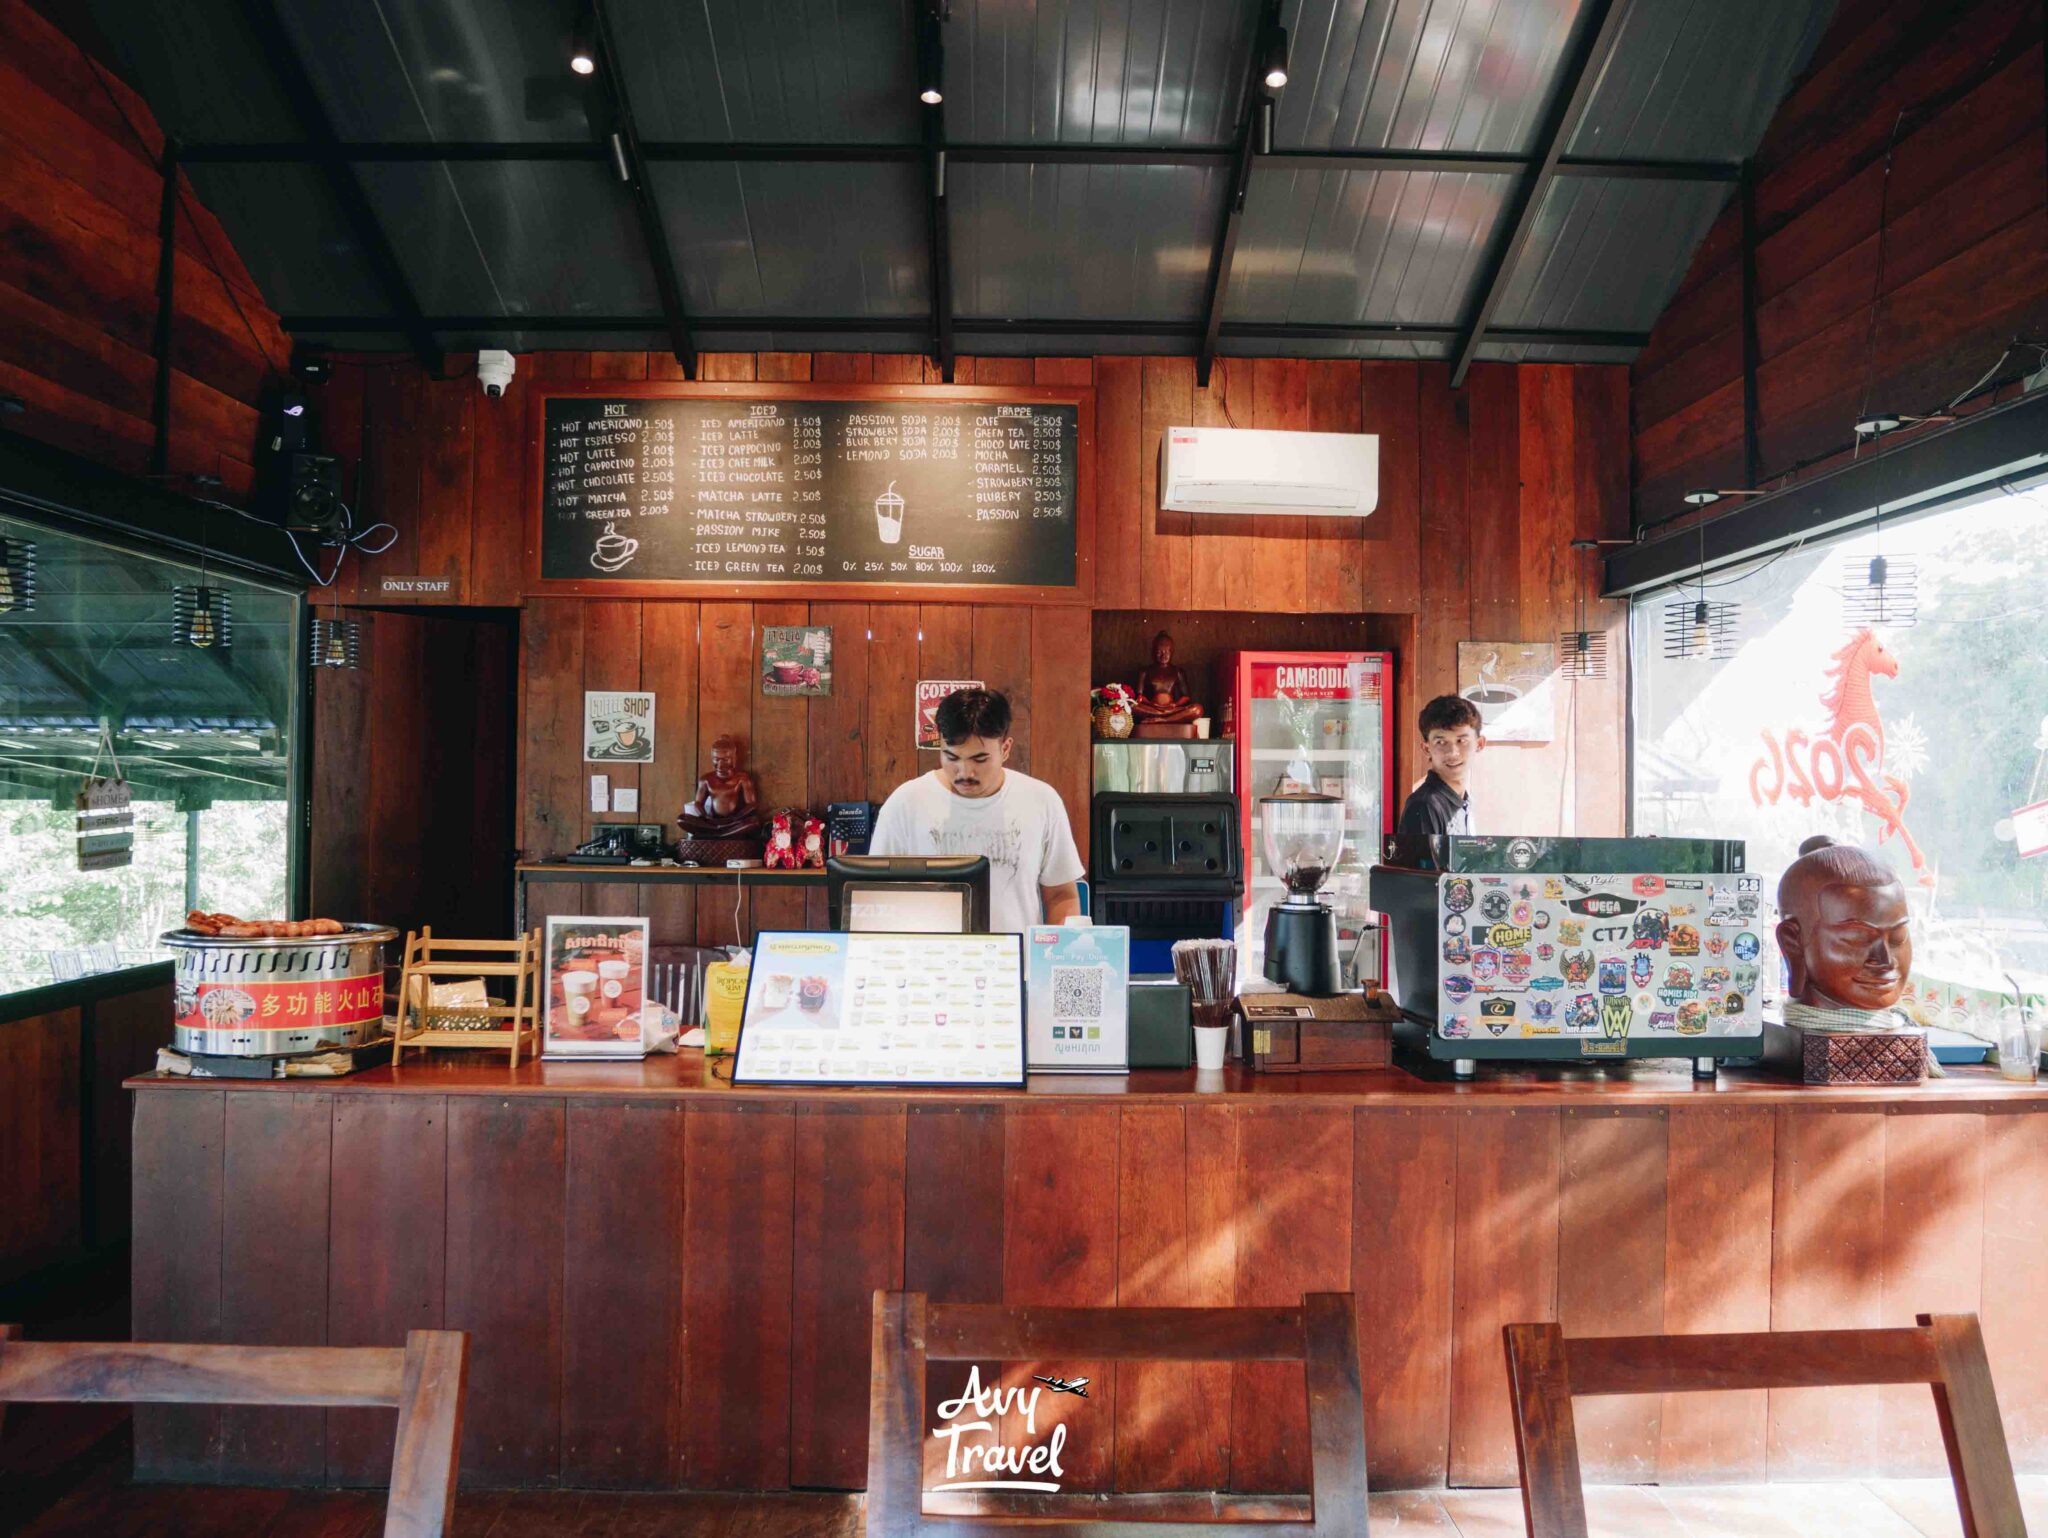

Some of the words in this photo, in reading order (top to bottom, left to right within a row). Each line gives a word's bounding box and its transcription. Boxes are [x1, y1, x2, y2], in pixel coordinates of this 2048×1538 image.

[604, 404, 627, 415] HOT
[750, 405, 777, 415] ICED
[997, 406, 1032, 416] FRAPPE
[561, 421, 580, 432] HOT
[588, 419, 642, 431] AMERICANO
[644, 419, 674, 430] 1.50$
[701, 419, 722, 429] ICED
[728, 419, 785, 429] AMERICANO
[793, 416, 821, 427] 1.50$
[849, 415, 895, 425] PASSION
[901, 415, 927, 425] SODA
[975, 416, 999, 426] CAFE
[1033, 416, 1062, 427] 2.50$
[701, 431, 723, 441] ICED
[729, 430, 759, 441] LATTE
[793, 427, 821, 438] 2.00$
[902, 426, 927, 436] SODA
[932, 427, 960, 437] 2.00$
[974, 428, 1004, 438] GREEN
[1008, 428, 1025, 438] TEA
[1033, 427, 1061, 438] 2.50$
[560, 438, 579, 448] HOT
[585, 433, 636, 446] ESPRESSO
[641, 430, 674, 443] 2.00$
[902, 437, 926, 446] SODA
[1033, 439, 1061, 450] 2.50$
[560, 452, 579, 463] HOT
[587, 448, 616, 460] LATTE
[643, 445, 674, 456] 2.00$
[701, 445, 725, 456] ICED
[793, 439, 821, 449] 2.00$
[700, 459, 725, 469] ICED
[728, 458, 751, 468] CAFE
[753, 457, 776, 467] MILK
[793, 452, 822, 464] 2.00$
[899, 449, 928, 460] SODA
[975, 450, 1008, 461] MOCHA
[1033, 453, 1062, 464] 2.50$
[559, 465, 576, 477] HOT
[642, 456, 674, 469] 2.00$
[975, 463, 1024, 474] CARAMEL
[1032, 464, 1061, 475] 2.50$
[558, 480, 576, 491] HOT
[583, 473, 635, 488] CHOCOLATE
[643, 470, 674, 483] 2.50$
[699, 472, 725, 482] ICED
[728, 471, 784, 482] CHOCOLATE
[794, 468, 822, 481] 2.50$
[976, 477, 1034, 489] STROWBERY
[1035, 477, 1061, 488] 2.50$
[558, 496, 578, 506] HOT
[641, 488, 674, 502] 2.50$
[698, 491, 744, 502] MATCHA
[751, 492, 783, 502] LATTE
[792, 490, 821, 502] 2.50$
[1034, 490, 1061, 502] 2.50$
[586, 509, 614, 519] GREEN
[616, 509, 631, 518] TEA
[640, 505, 669, 516] 2.00$
[697, 508, 741, 520] MATCHA
[800, 513, 826, 524] 2.50$
[976, 508, 1020, 520] PASSION
[1033, 506, 1062, 518] 2.50$
[696, 524, 744, 536] PASSION
[799, 528, 826, 539] 2.50$
[695, 543, 720, 553] ICED
[768, 543, 785, 553] TEA
[796, 546, 825, 556] 1.50$
[908, 545, 945, 557] SUGAR
[695, 561, 720, 571] ICED
[725, 561, 760, 572] GREEN
[767, 563, 785, 573] TEA
[793, 563, 823, 574] 2.00$
[842, 561, 857, 571] 0%
[864, 562, 885, 572] 25%
[890, 562, 908, 572] 50%
[940, 563, 963, 573] 100%
[971, 563, 996, 573] 120%
[383, 581, 414, 591] ONLY
[416, 581, 450, 592] STAFF
[768, 630, 801, 642] ITALIA
[1276, 666, 1352, 689] CAMBODIA
[624, 697, 650, 719] SHOP
[1739, 880, 1758, 892] 28
[1588, 900, 1621, 914] WEGA
[1495, 928, 1531, 943] HOME
[1592, 927, 1628, 942] CT7
